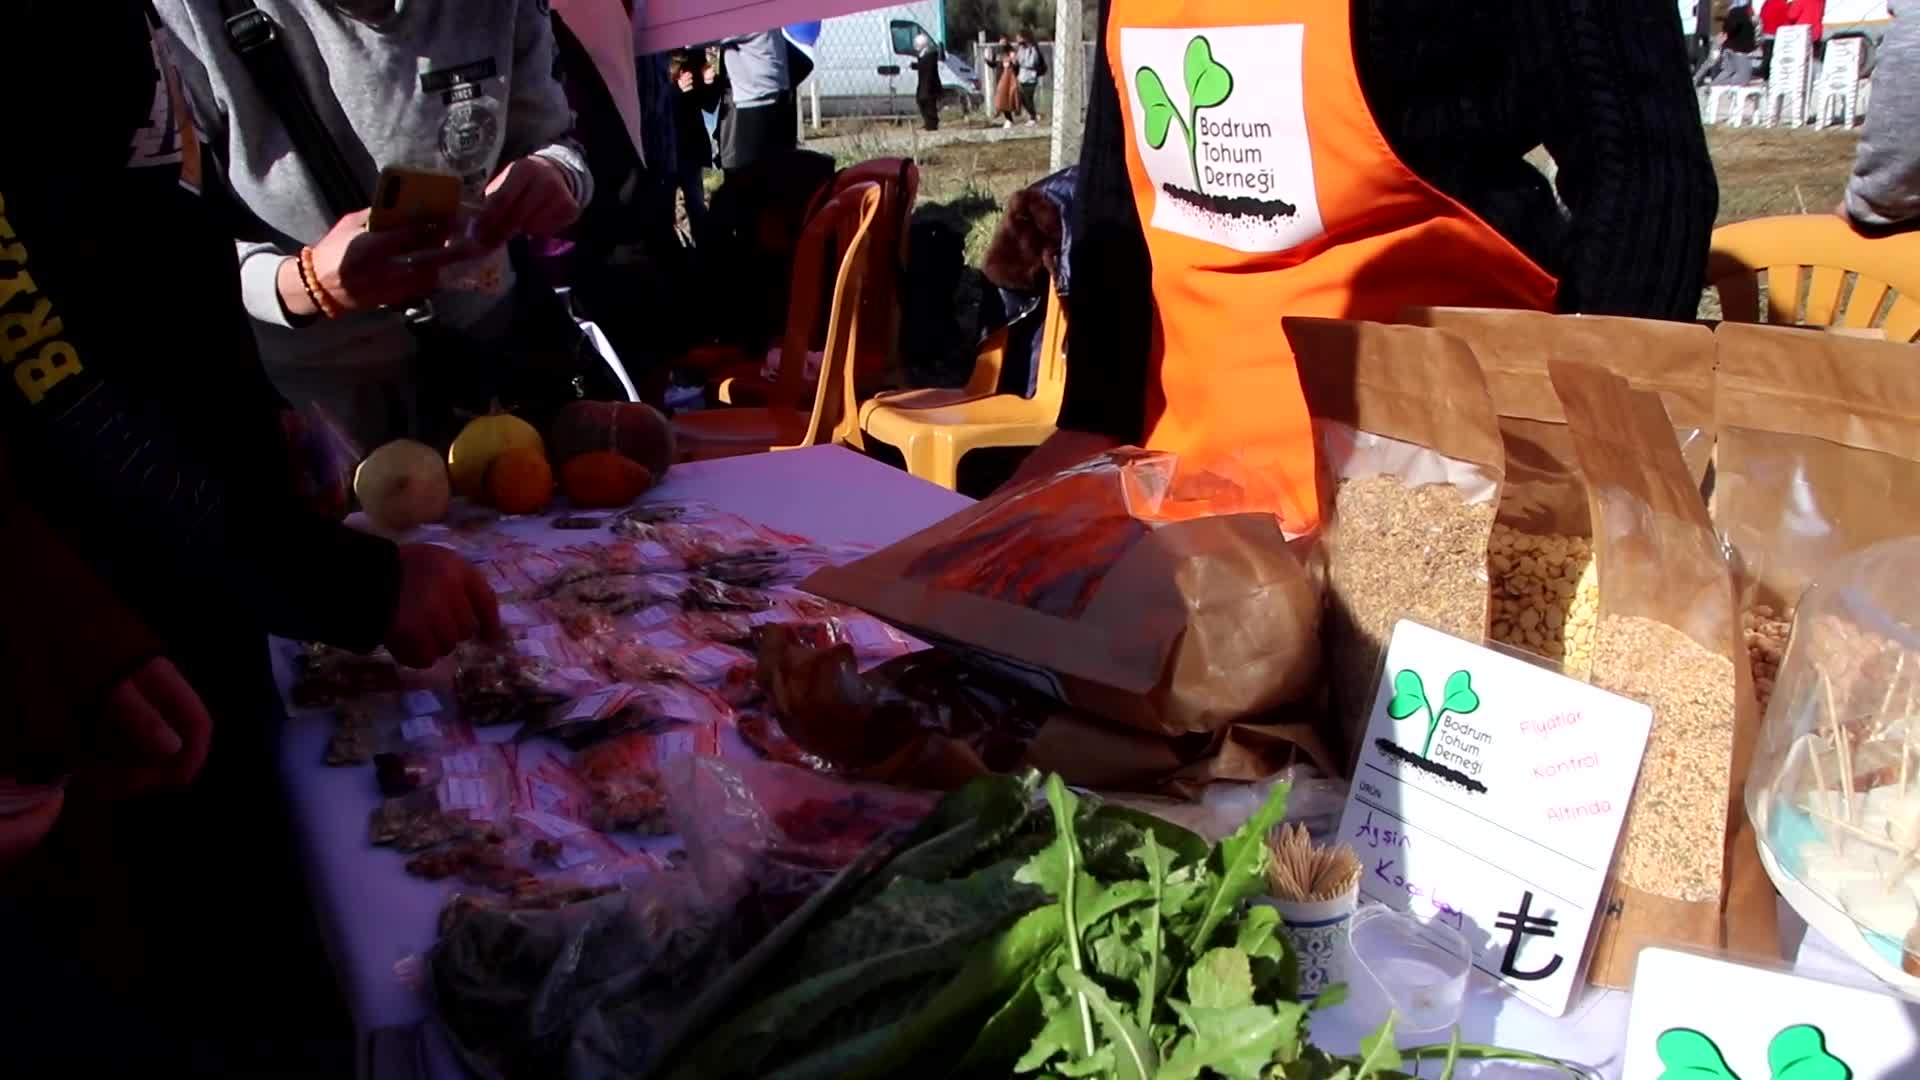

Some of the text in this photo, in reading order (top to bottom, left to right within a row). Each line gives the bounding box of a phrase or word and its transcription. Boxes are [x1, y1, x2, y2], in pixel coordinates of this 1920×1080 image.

[1200, 116, 1272, 138] Bodrum
[1202, 141, 1263, 164] Tohum
[1204, 165, 1276, 194] Derneği
[1439, 730, 1480, 757] Tohum
[1443, 715, 1493, 745] Bodrum
[1434, 744, 1484, 775] Derneği
